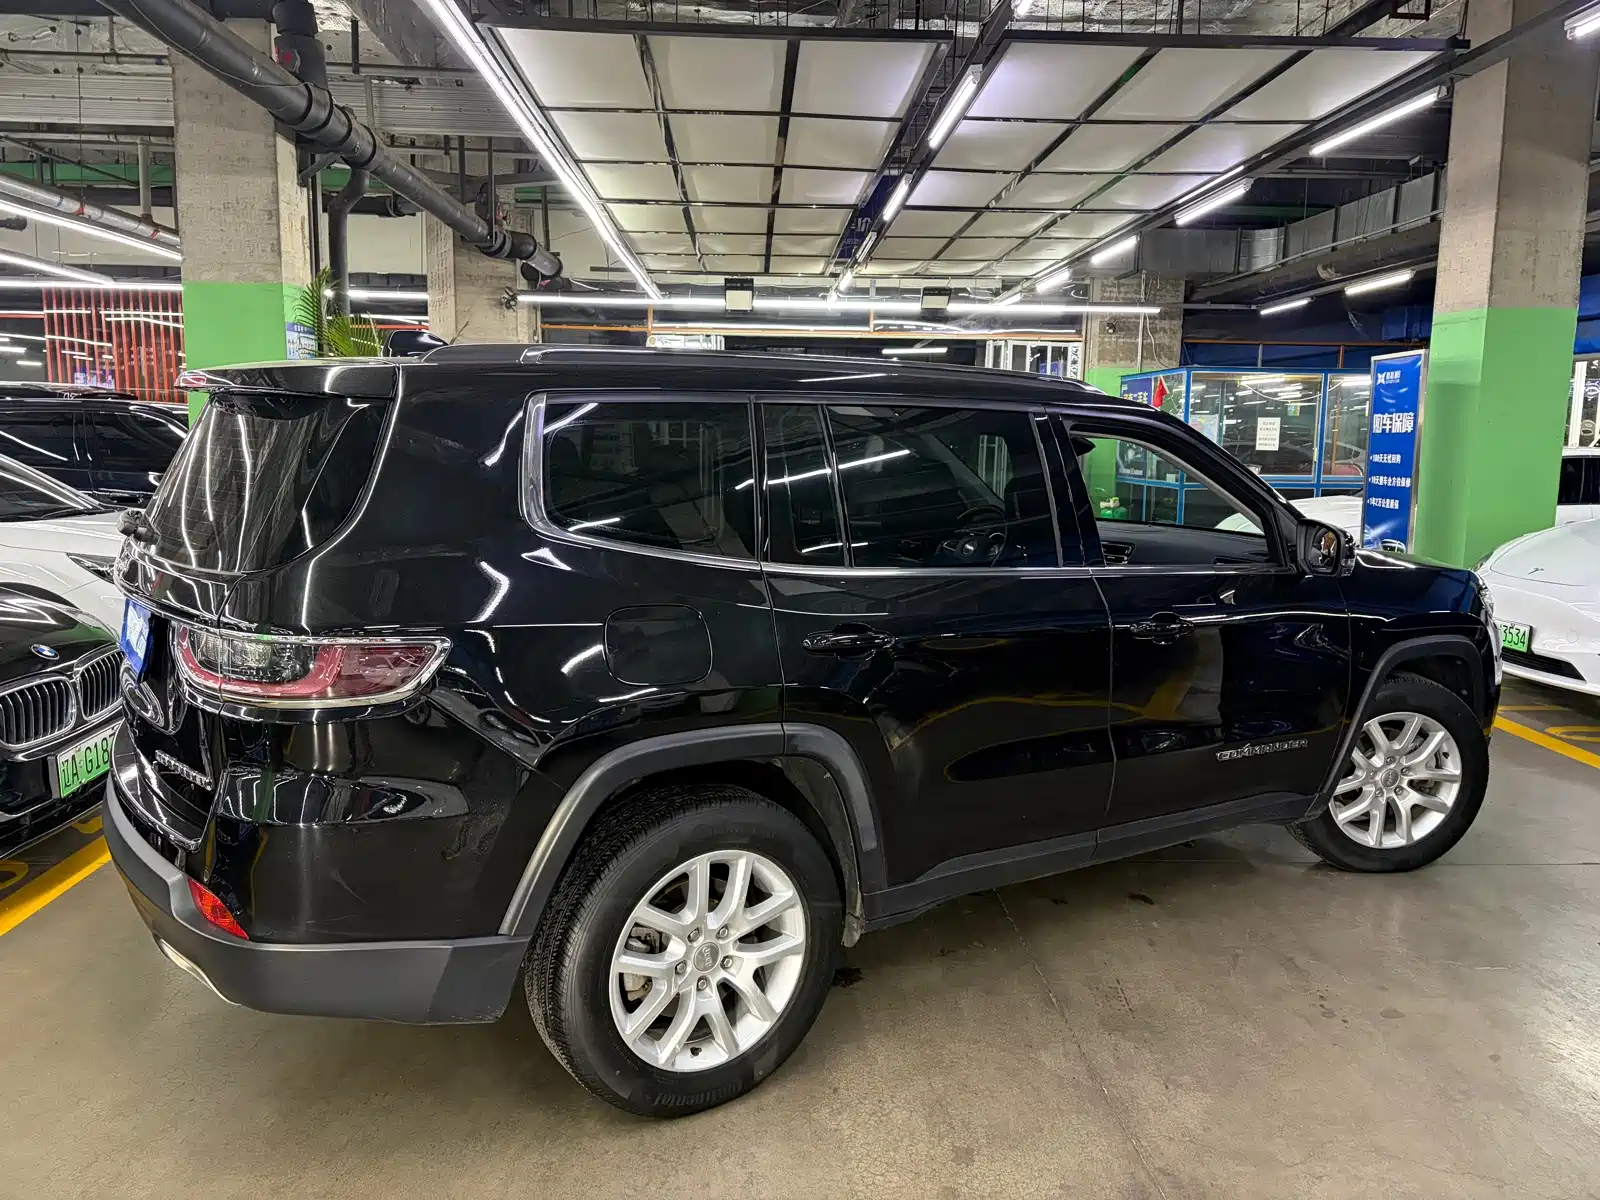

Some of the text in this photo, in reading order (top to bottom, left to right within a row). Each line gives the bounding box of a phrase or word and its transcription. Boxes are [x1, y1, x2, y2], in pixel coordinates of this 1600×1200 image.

[1373, 412, 1414, 433] 购车保障
[1500, 624, 1527, 648] 3534
[1216, 738, 1309, 762] COMMANDER
